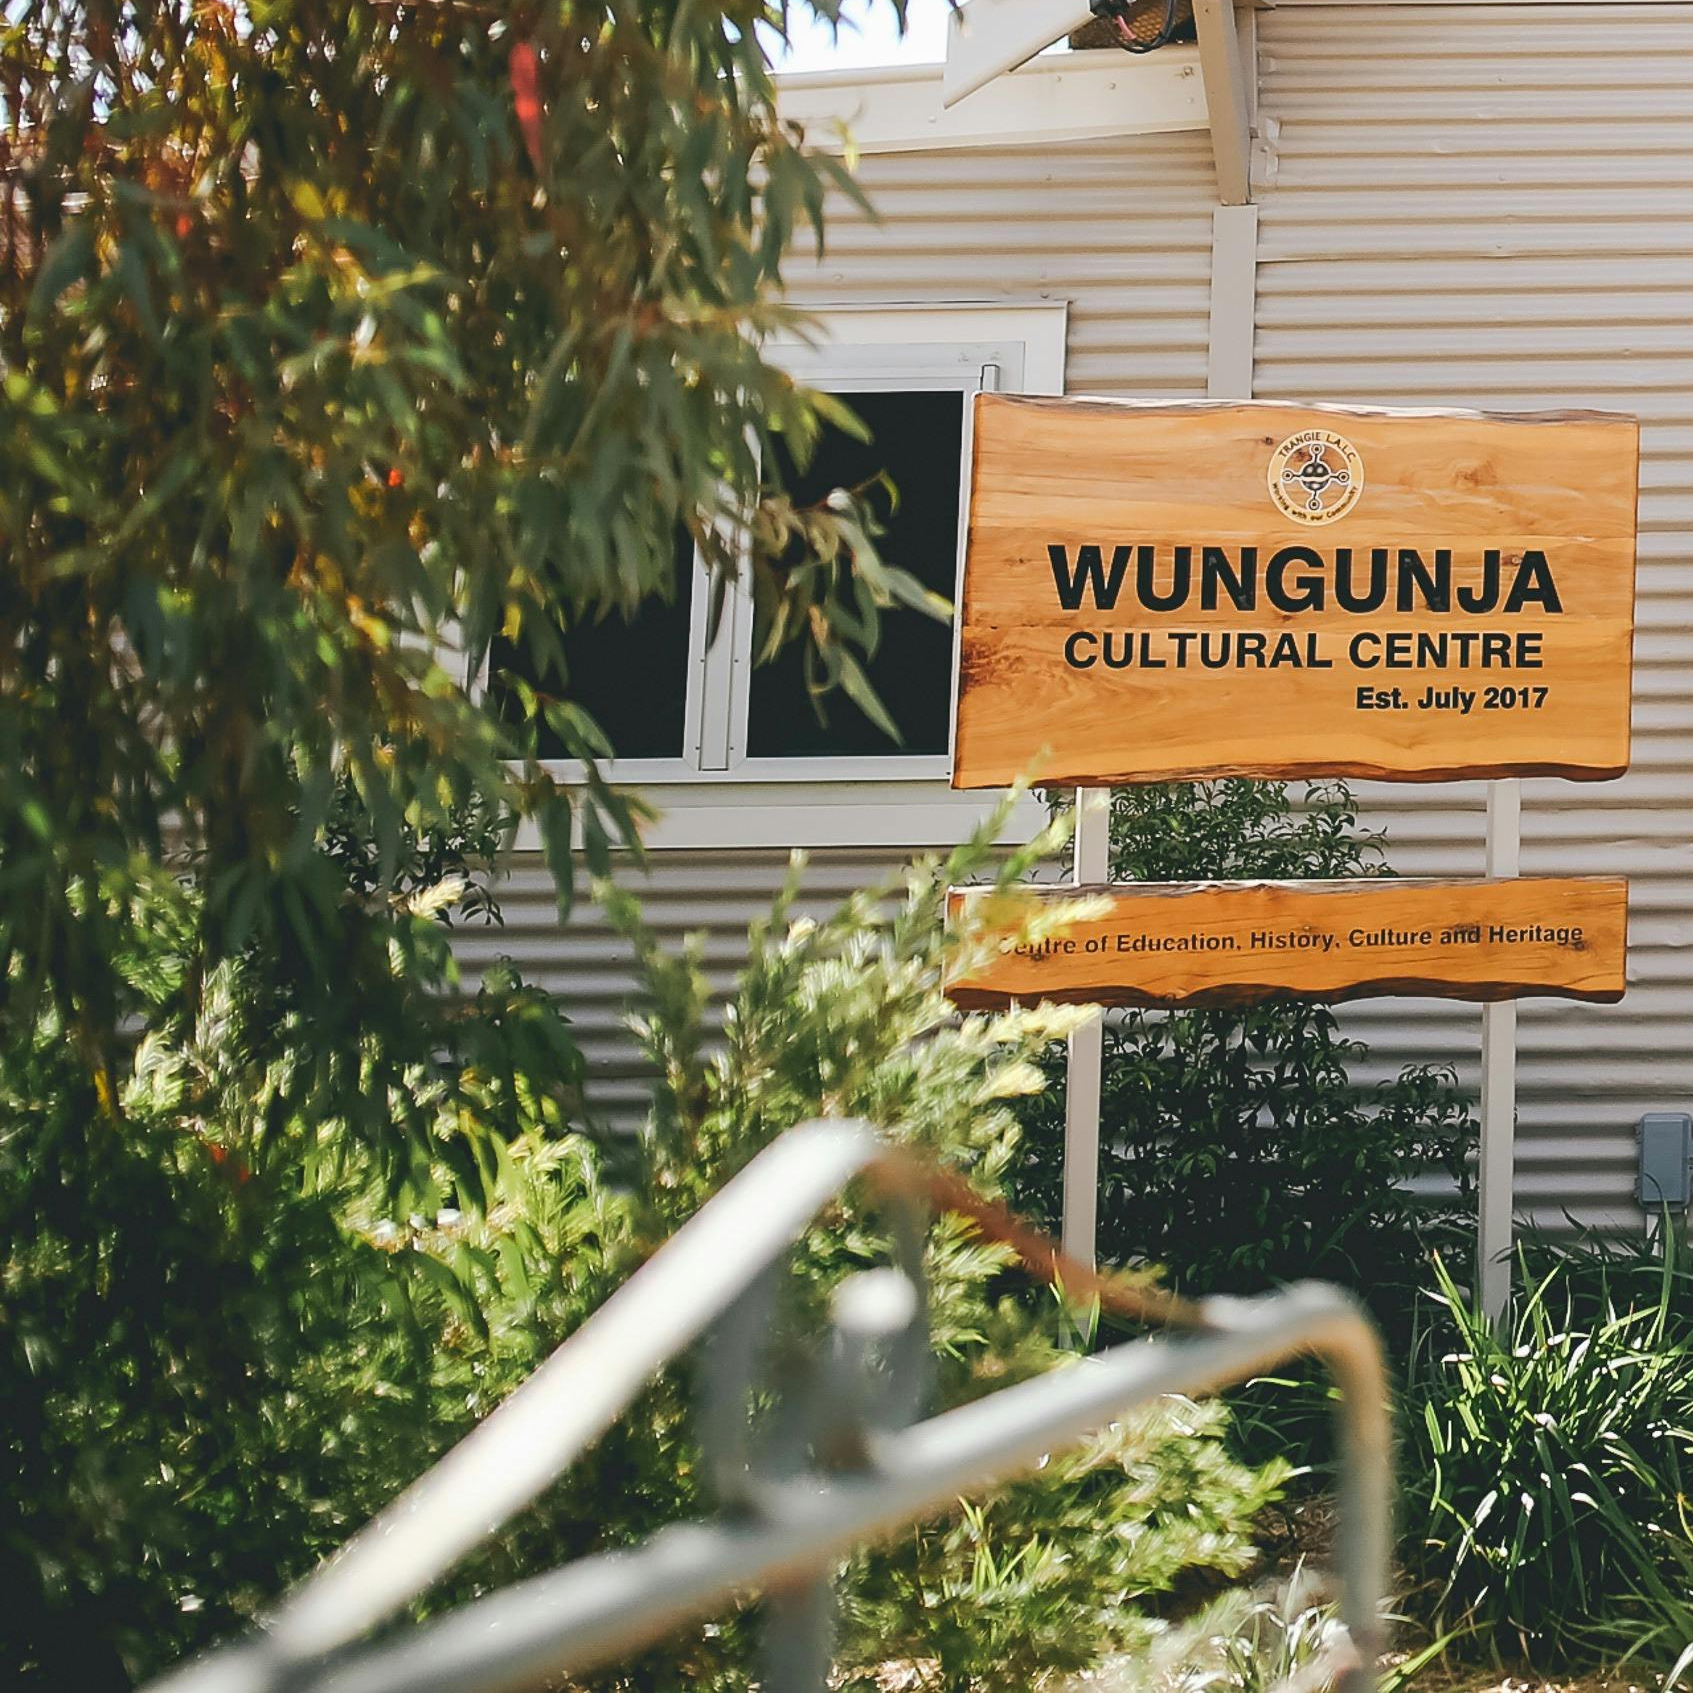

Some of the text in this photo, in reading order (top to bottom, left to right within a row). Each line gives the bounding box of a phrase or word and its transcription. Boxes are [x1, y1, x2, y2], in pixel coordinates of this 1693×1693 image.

[1279, 432, 1321, 458] TRANGIE
[1047, 545, 1562, 613] WUNGUNJA
[1064, 632, 1543, 669] CULTURAL CENTRE
[1356, 687, 1549, 714] Est. July 2017
[1085, 935, 1108, 953] of
[1349, 928, 1433, 948] Culture
[1440, 924, 1481, 945] and
[1488, 923, 1584, 946] Heritage
